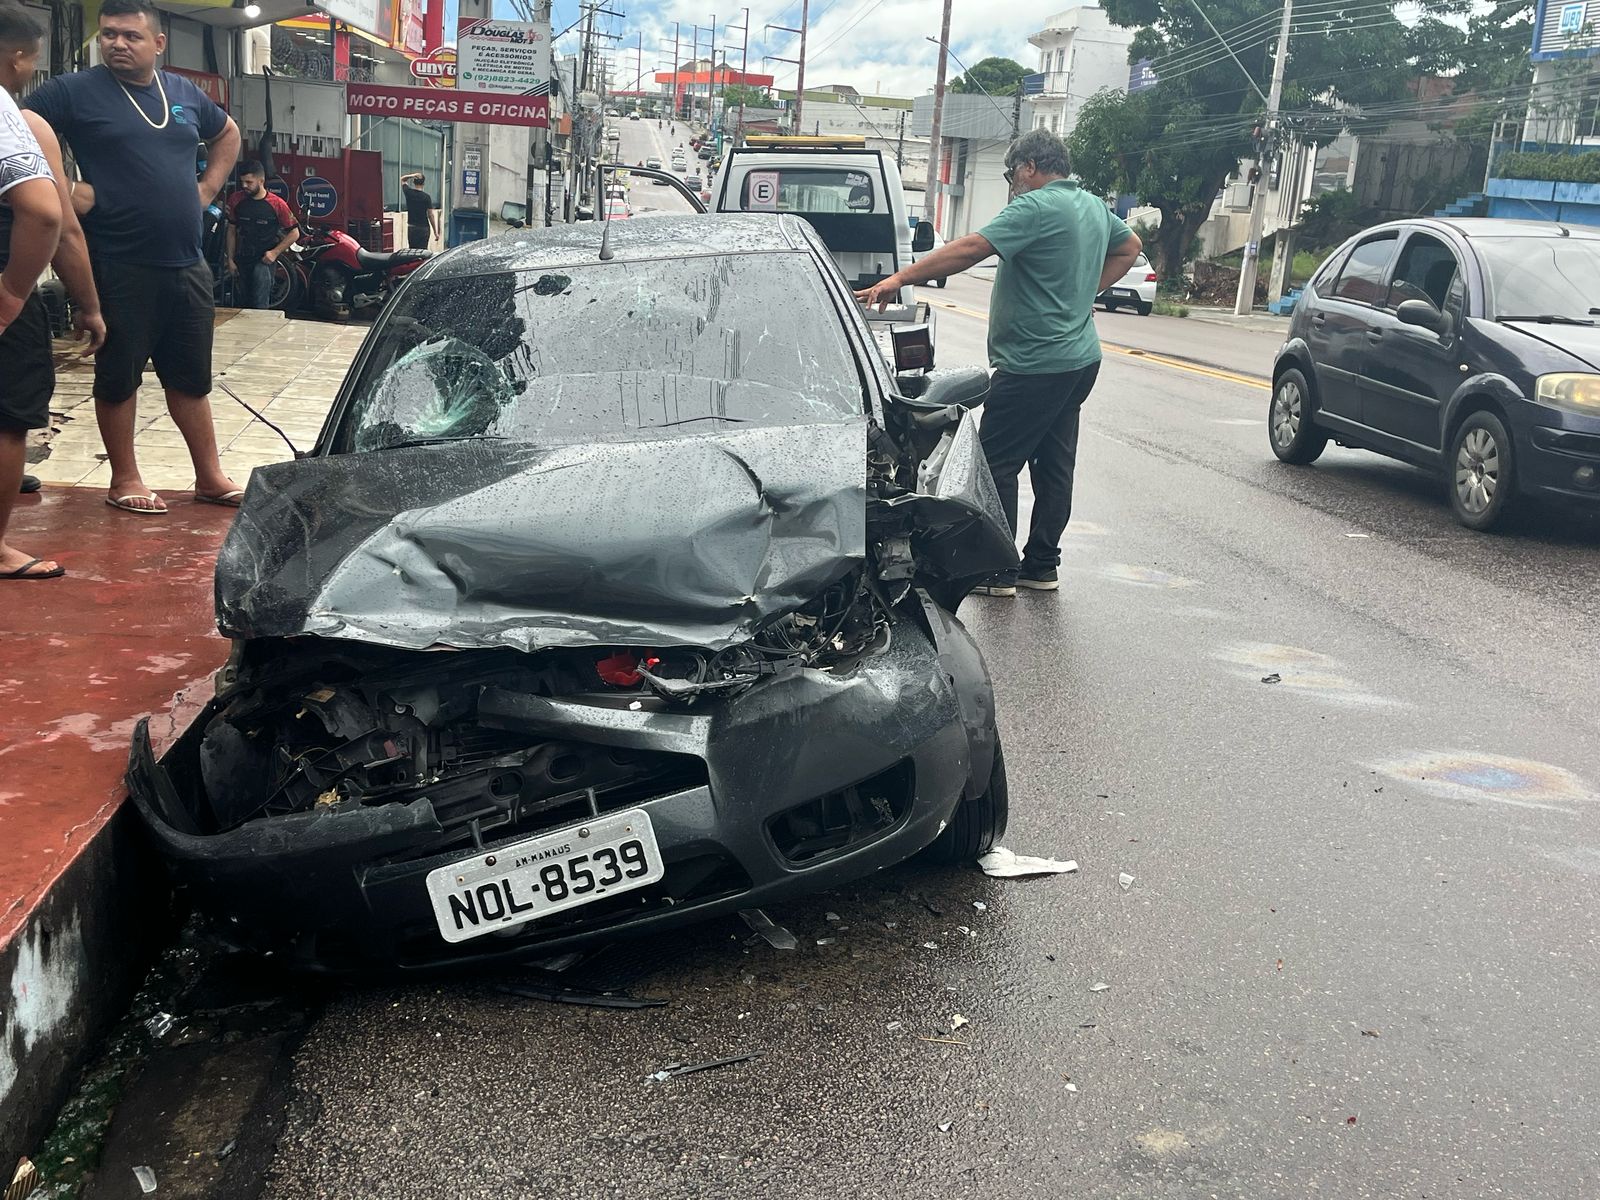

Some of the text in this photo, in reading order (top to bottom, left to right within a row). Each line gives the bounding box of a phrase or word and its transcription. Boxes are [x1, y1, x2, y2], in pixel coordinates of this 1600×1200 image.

[470, 26, 524, 38] DOUGLAS
[500, 47, 537, 55] SERVIÇOS
[474, 74, 541, 84] (92)8823-4429
[349, 94, 547, 119] MOTO PEÇAS E OFICINA
[758, 184, 769, 199] E
[515, 843, 571, 867] AM-MANAUS
